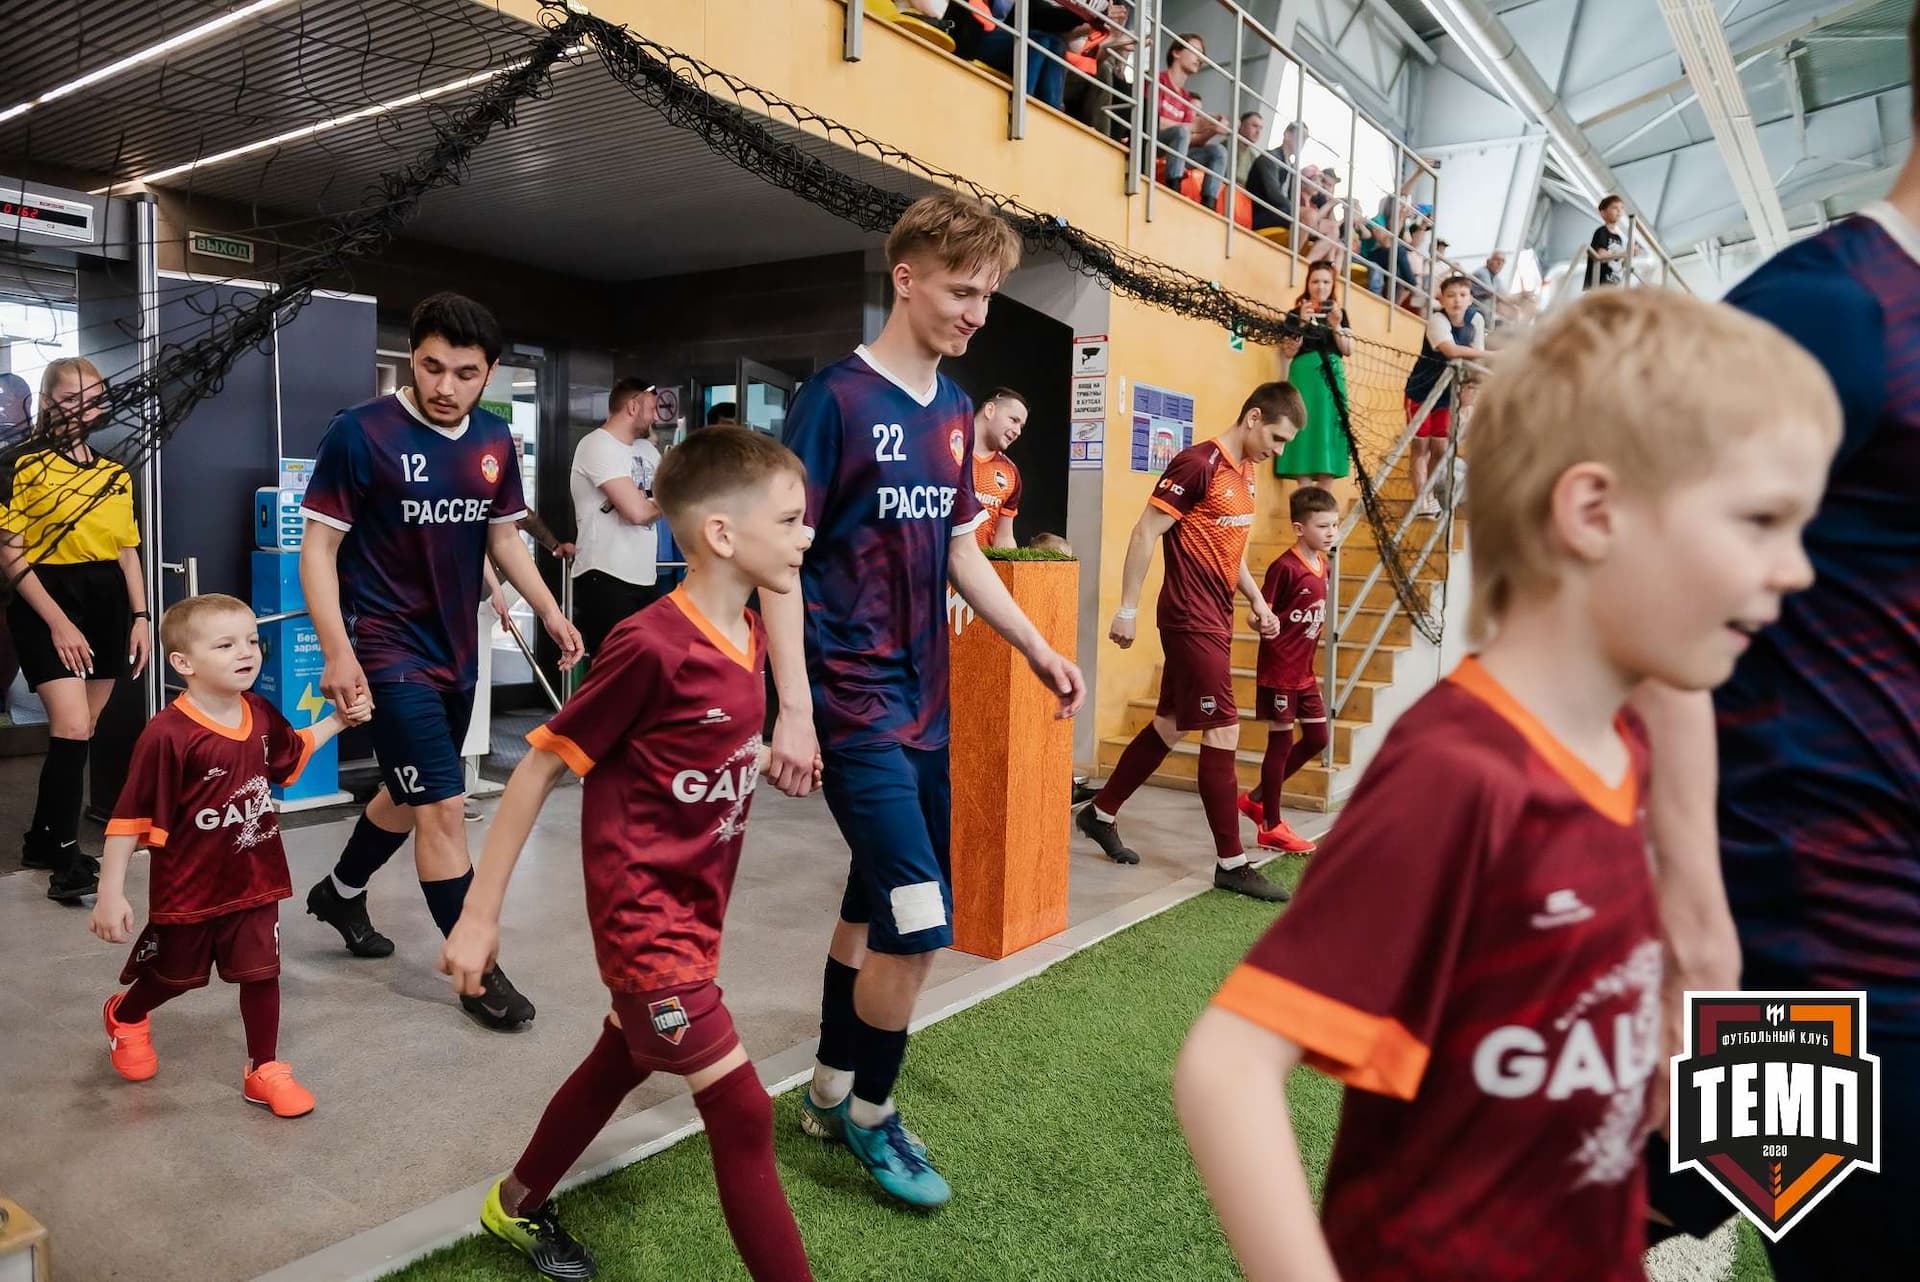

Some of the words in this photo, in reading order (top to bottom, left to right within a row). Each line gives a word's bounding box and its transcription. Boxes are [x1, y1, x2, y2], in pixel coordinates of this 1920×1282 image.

[196, 237, 248, 258] ВЫХОД
[872, 423, 907, 462] 22
[400, 453, 429, 482] 12
[877, 485, 957, 519] РАССВ
[296, 633, 319, 644] Бер
[394, 765, 426, 793] 12
[195, 793, 275, 830] GALA
